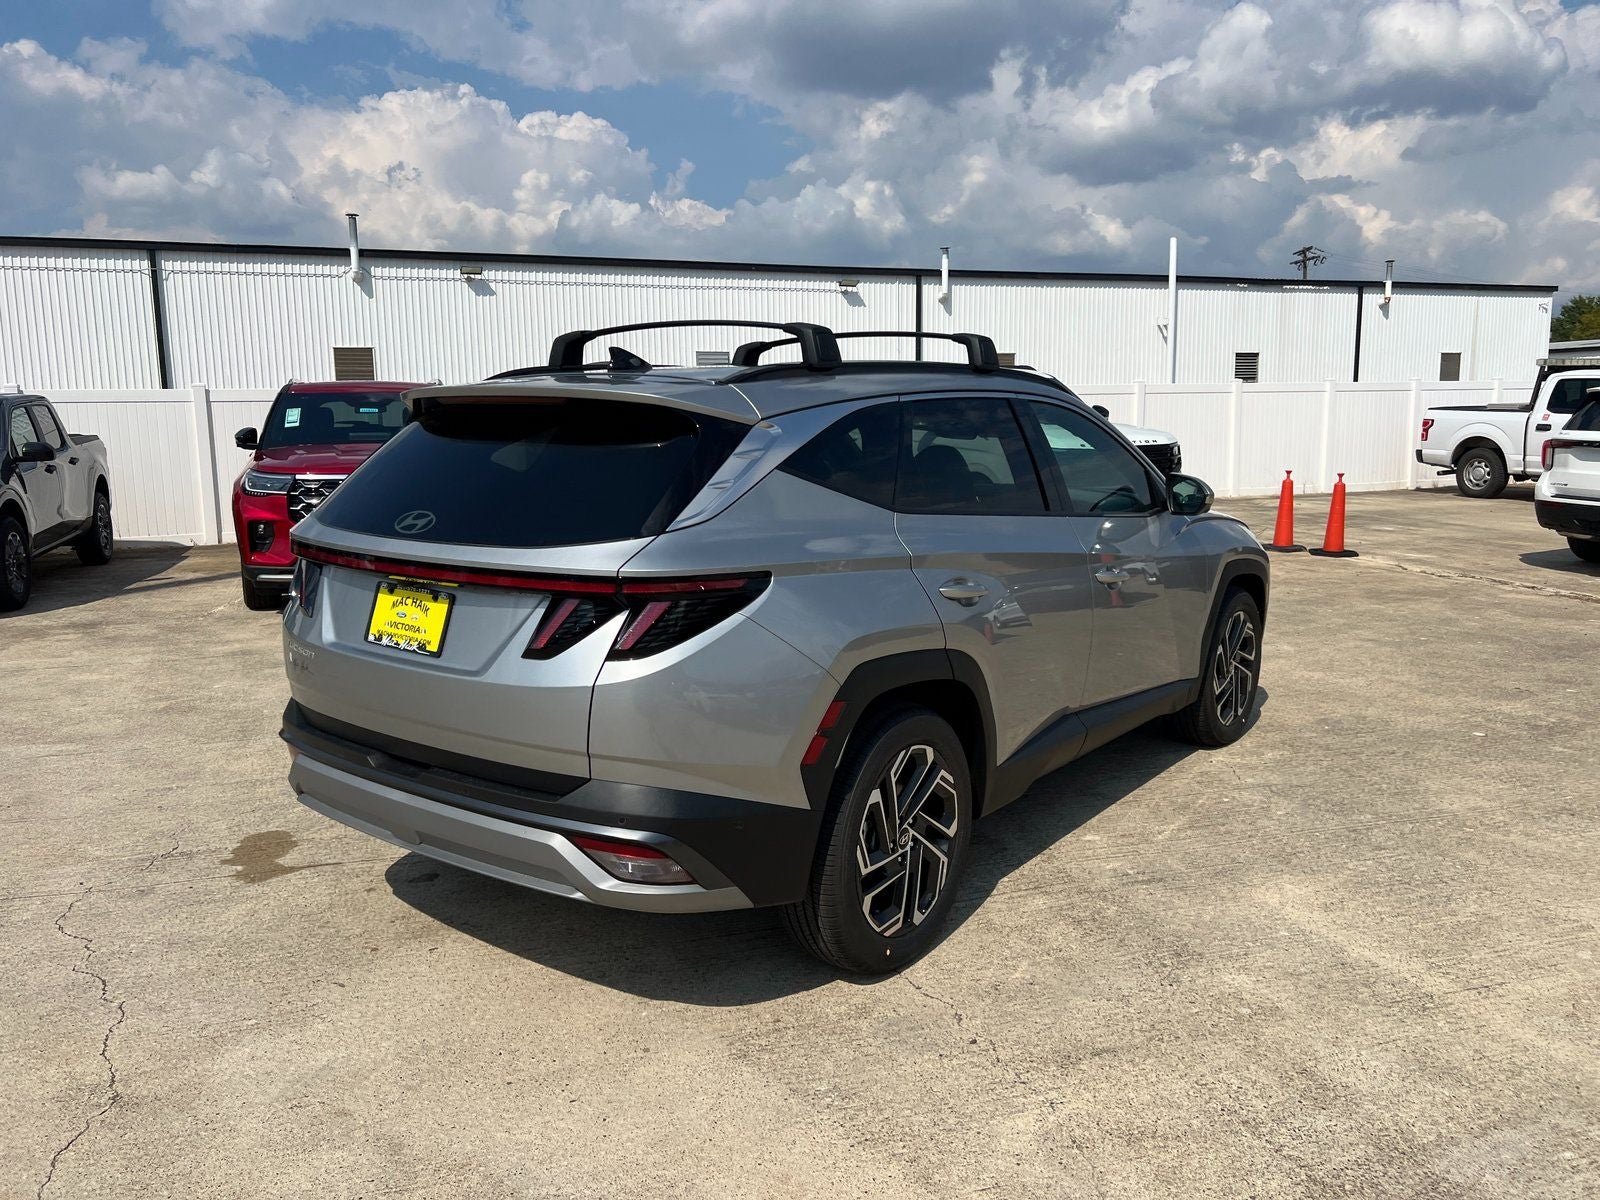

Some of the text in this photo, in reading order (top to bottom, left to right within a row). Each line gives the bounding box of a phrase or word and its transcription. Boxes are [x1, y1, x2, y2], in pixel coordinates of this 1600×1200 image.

[390, 596, 430, 617] MAC HAIK
[389, 620, 421, 634] VICTORIA
